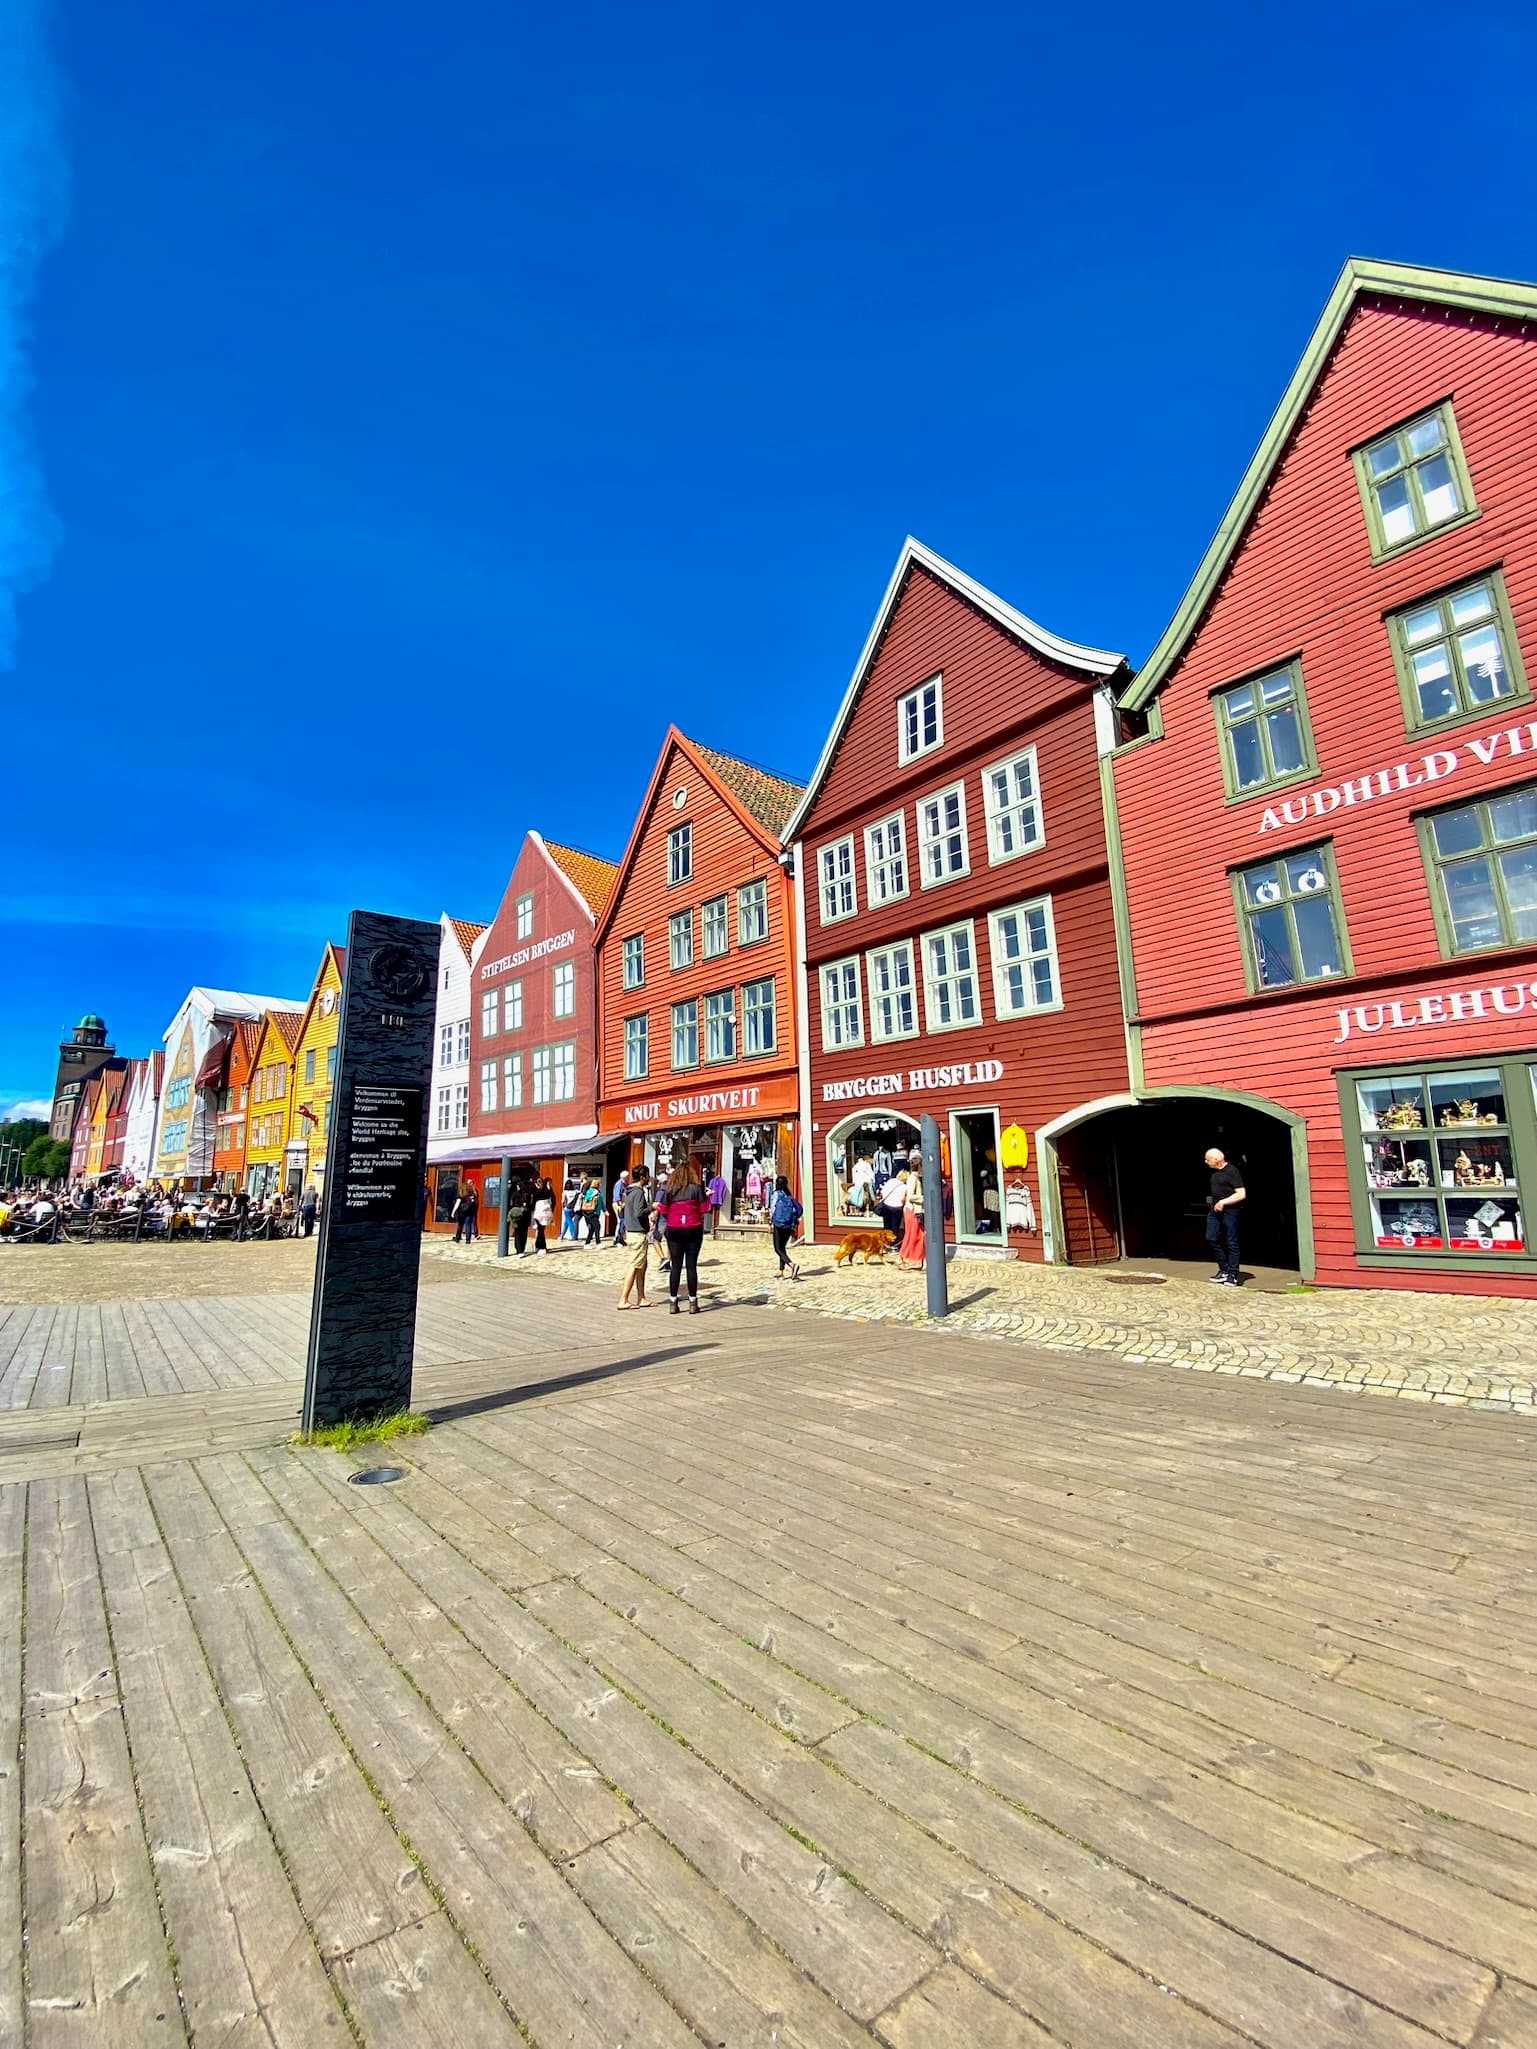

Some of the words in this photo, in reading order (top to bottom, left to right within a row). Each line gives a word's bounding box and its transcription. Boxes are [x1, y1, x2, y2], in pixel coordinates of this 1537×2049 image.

[1257, 750, 1459, 834] AUDHILD
[481, 947, 530, 980] STIFTELSEN
[530, 928, 576, 961] BRYGGEN
[823, 1073, 903, 1102] BRYGGEN
[908, 1059, 1004, 1091] HUSFLID
[624, 1102, 661, 1123] KNUT
[667, 1088, 760, 1118] SKURTVEIT
